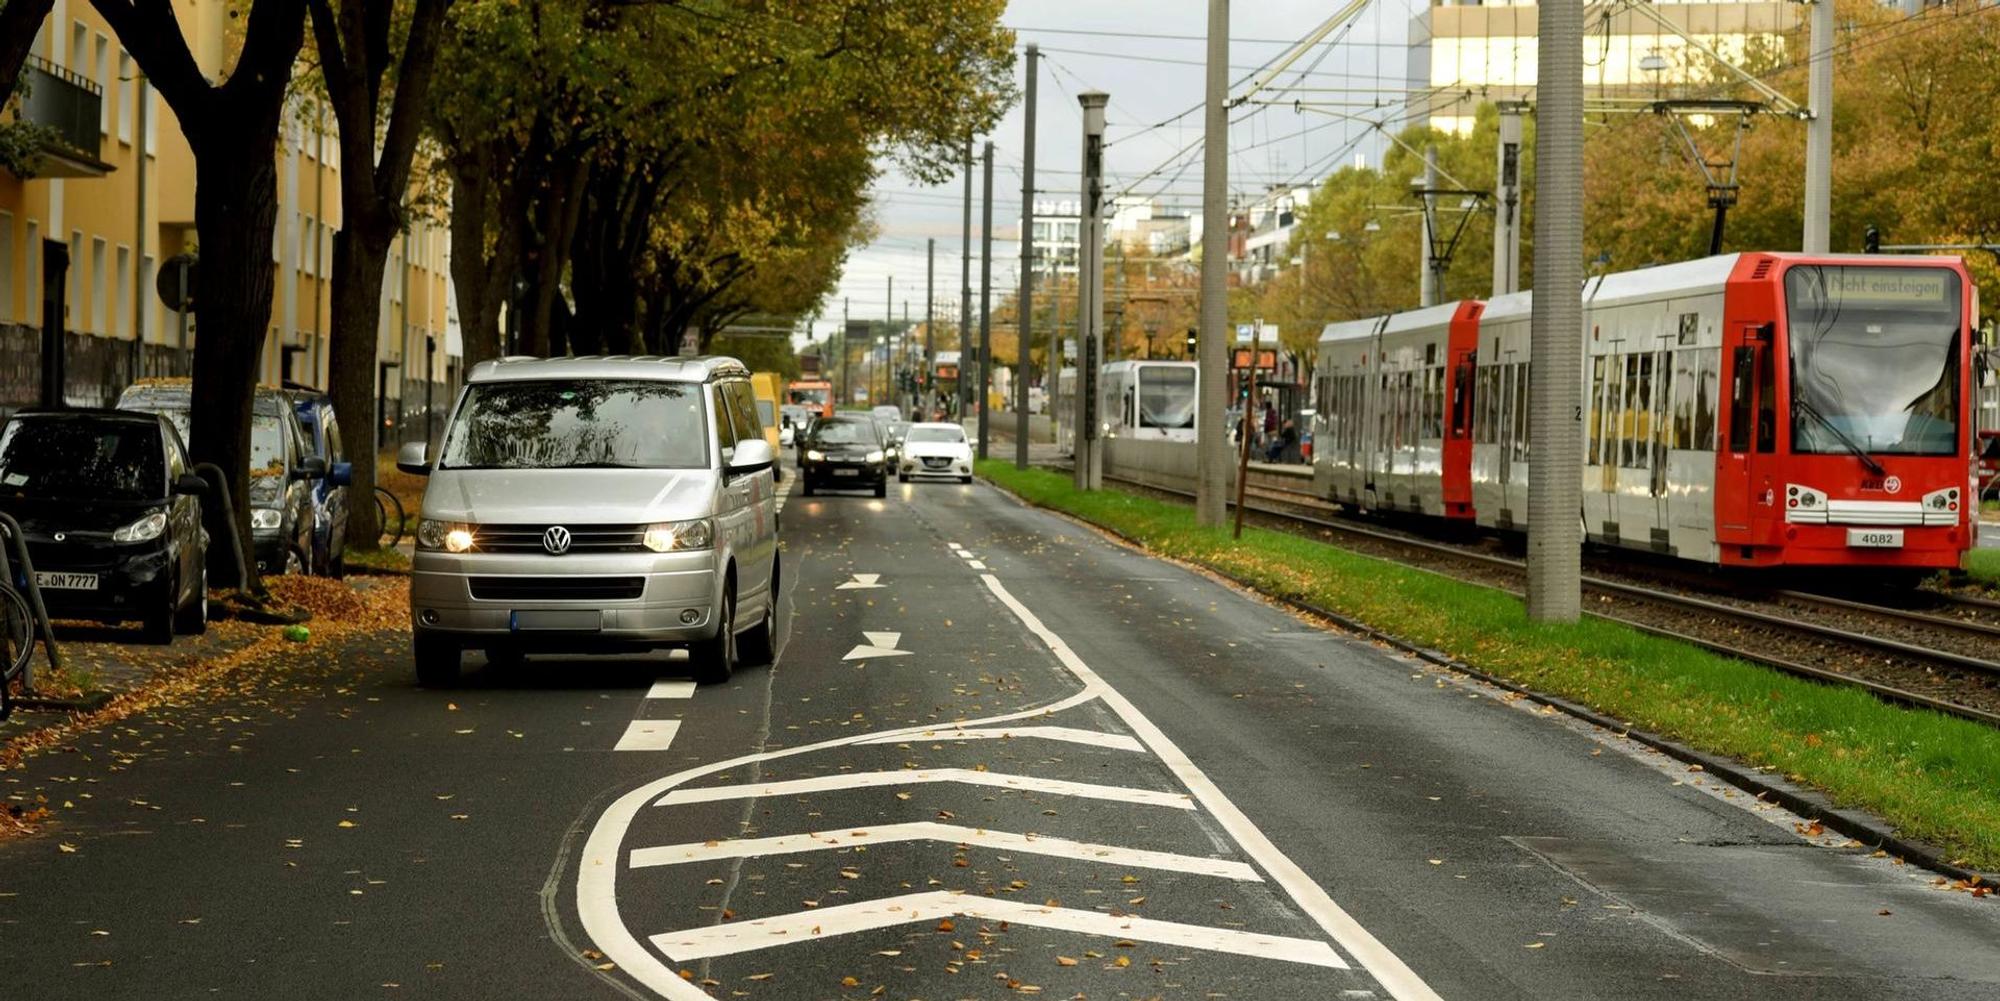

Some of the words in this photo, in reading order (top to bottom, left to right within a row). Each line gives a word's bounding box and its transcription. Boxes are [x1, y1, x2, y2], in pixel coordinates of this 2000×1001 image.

[1831, 276, 1867, 293] Nicht
[1871, 279, 1940, 297] einsteigen
[1862, 534, 1894, 544] 4082
[68, 575, 97, 588] 7777
